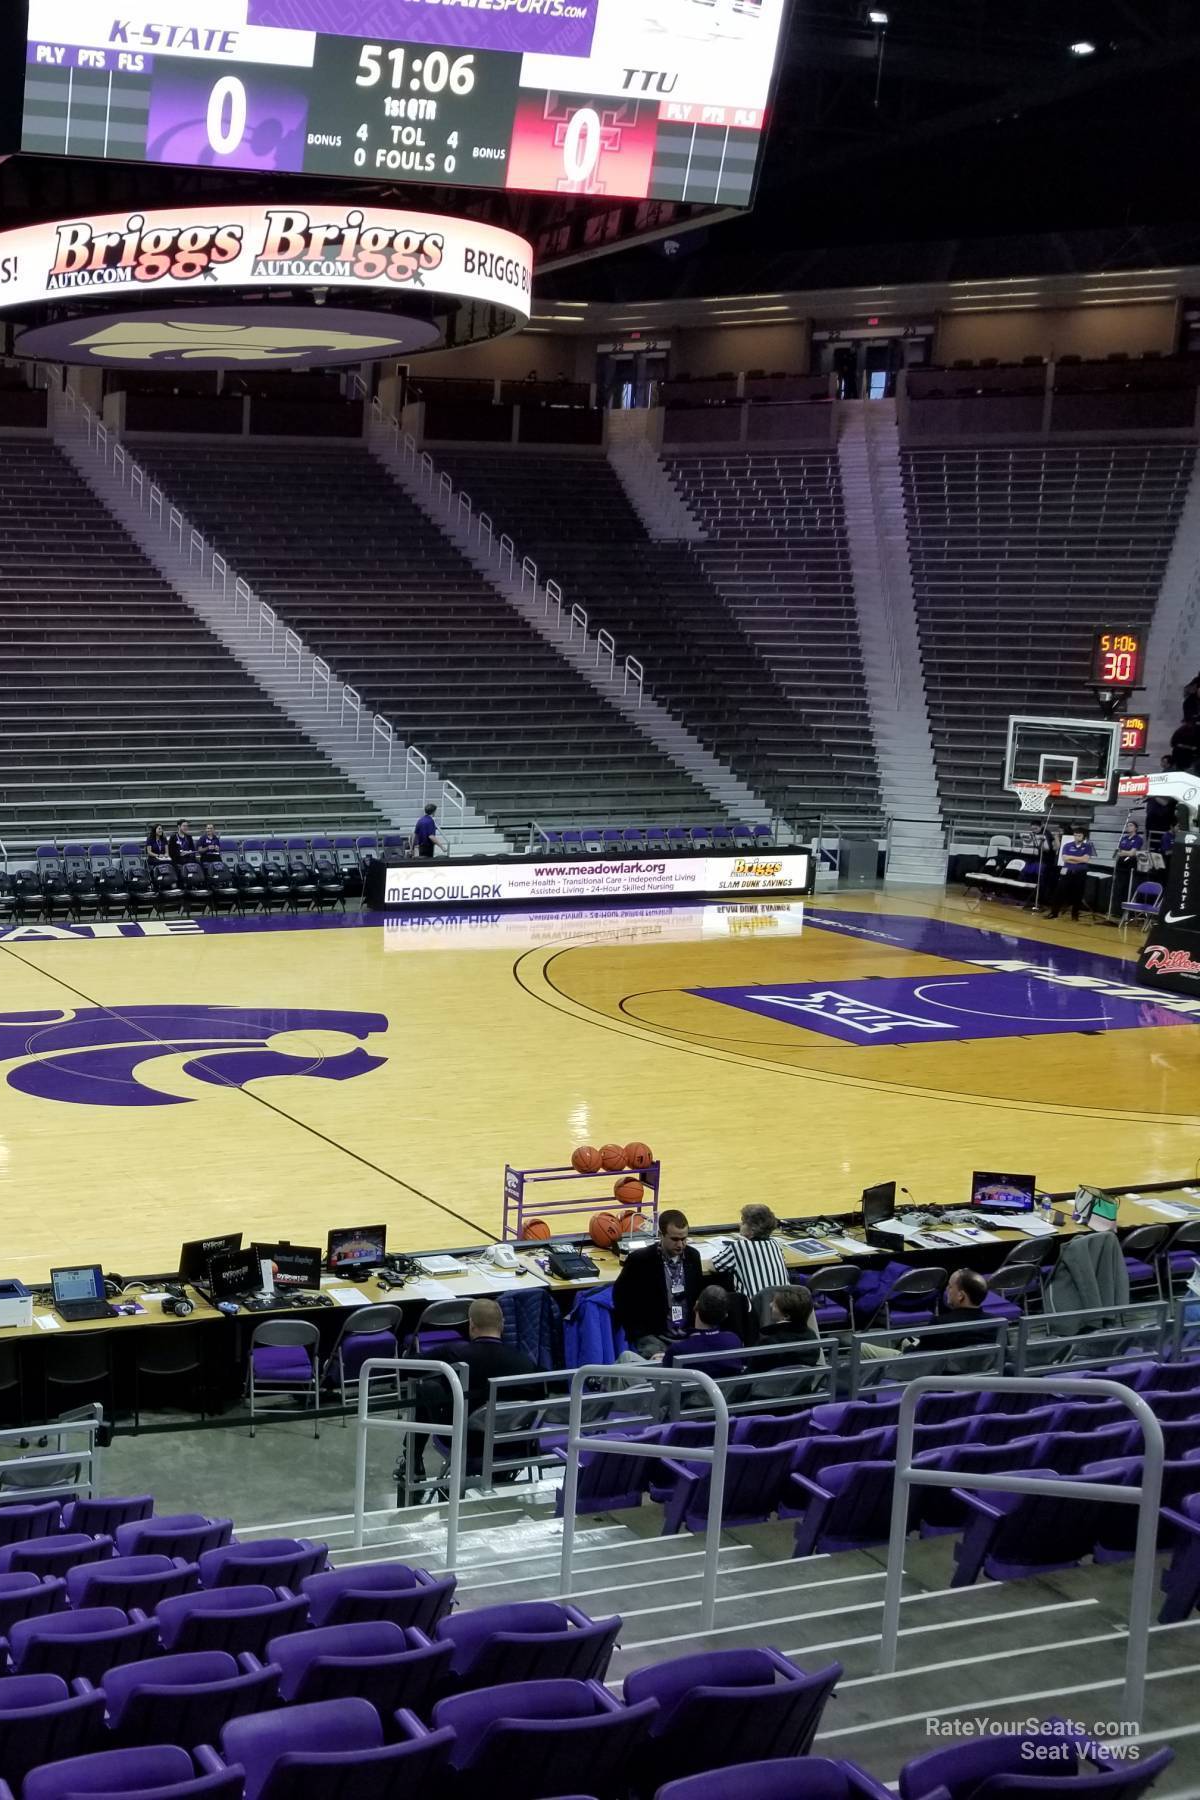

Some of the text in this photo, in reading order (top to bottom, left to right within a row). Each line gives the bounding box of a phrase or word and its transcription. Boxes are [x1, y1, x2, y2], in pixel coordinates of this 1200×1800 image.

[108, 20, 240, 53] K-STATE
[36, 45, 145, 71] PLY PTS FLS
[355, 44, 475, 95] 51:06
[622, 68, 678, 93] TTU
[206, 75, 247, 155] 0
[407, 98, 437, 121] QTR
[307, 133, 341, 146] BONUS
[356, 123, 459, 149] 4 TOL 4
[564, 107, 600, 182] 0
[354, 148, 456, 173] 0 FOULS 0
[473, 146, 505, 159] BONUS
[47, 214, 243, 290] Briggs AUTO.COM
[252, 210, 445, 283] Briggs AUTO.COM
[464, 247, 520, 287] BRIGGS
[1102, 635, 1136, 652] 51:06
[1104, 653, 1131, 681] 30
[1122, 732, 1137, 747] 30
[535, 862, 666, 877] www.meadowlark.org
[735, 858, 782, 876] Briggs
[1179, 847, 1193, 910] WILDCATS
[387, 884, 502, 902] MEADOWLARK
[509, 873, 696, 888] Home Health Transitional Care Independent Living
[530, 883, 675, 895] Assisted Living 24-Hour Skilled Nursing
[719, 879, 793, 888] SLAM DUNK SAVINGS
